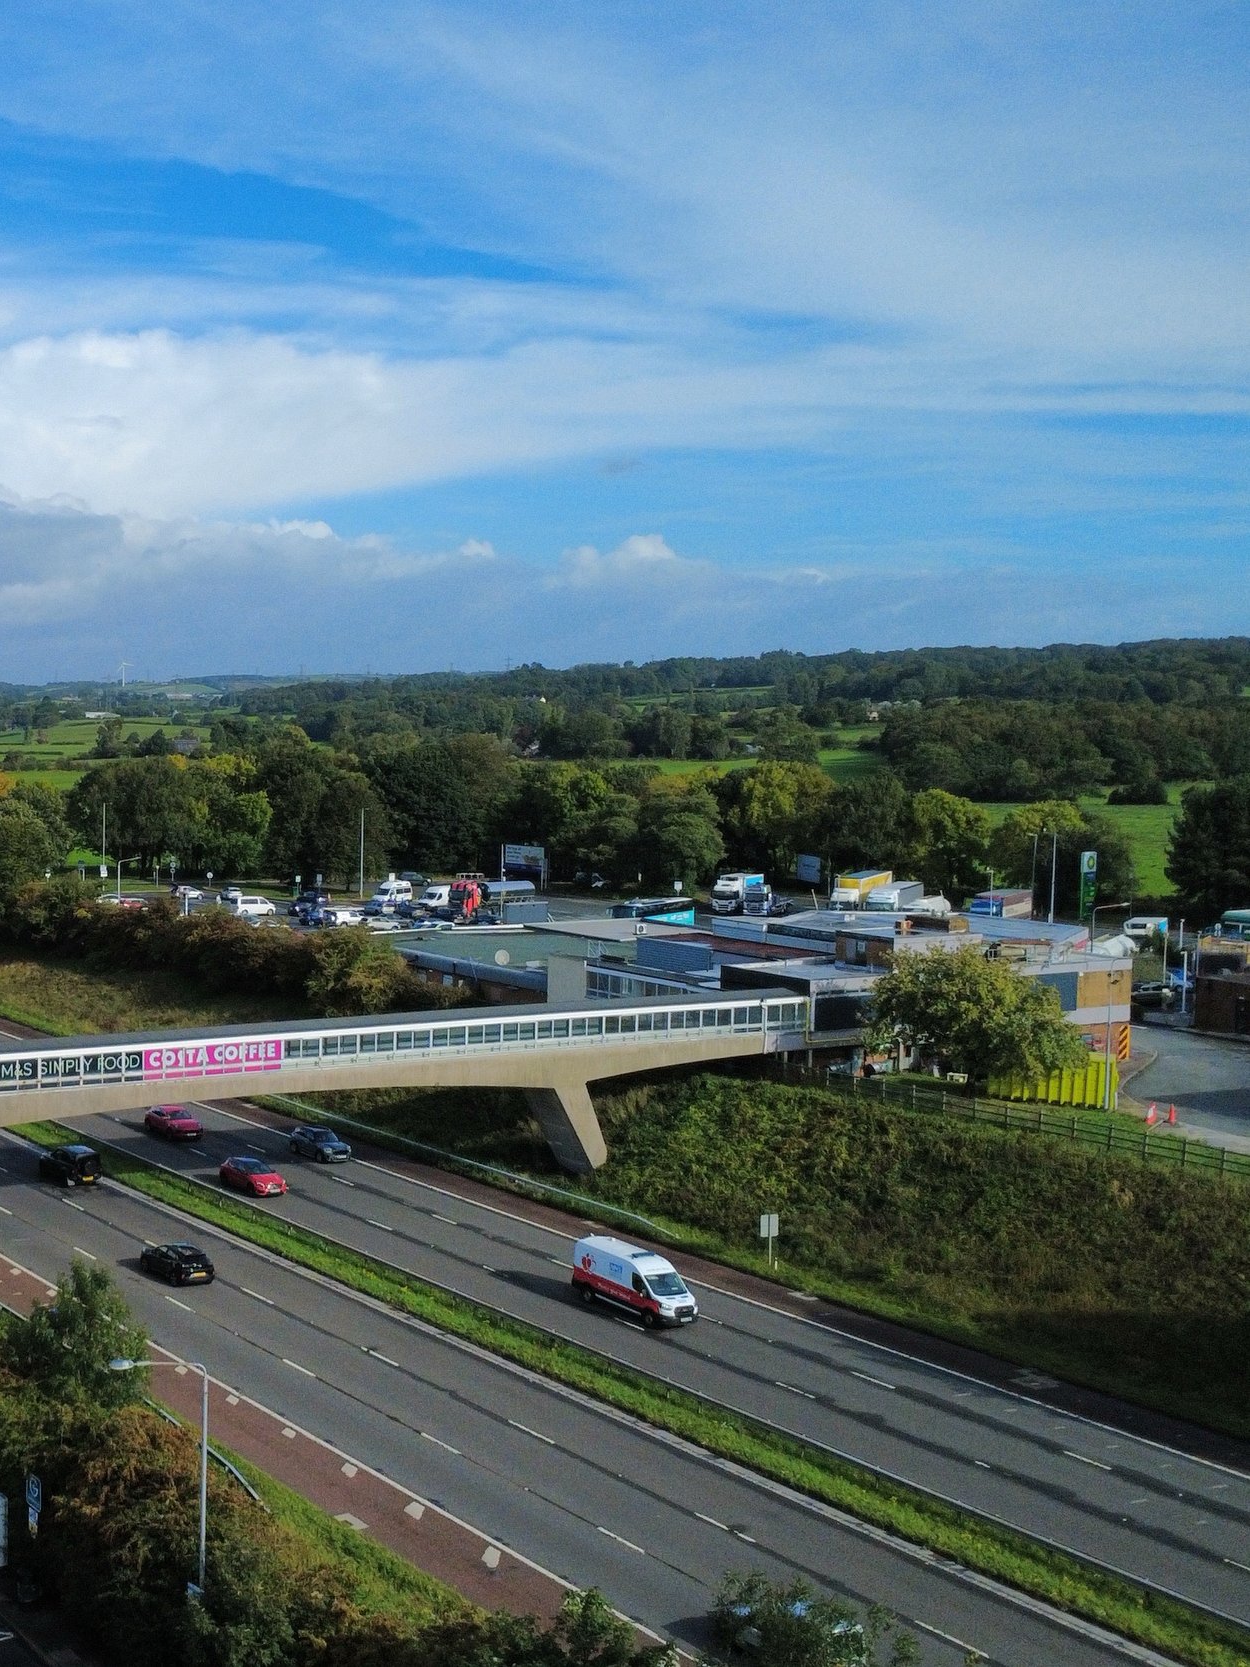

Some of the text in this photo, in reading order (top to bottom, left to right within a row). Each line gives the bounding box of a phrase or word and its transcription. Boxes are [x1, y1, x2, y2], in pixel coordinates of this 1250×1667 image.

[1, 1055, 140, 1078] M&S SIMPLY FOOD
[149, 1043, 276, 1067] COSTA COFFEE
